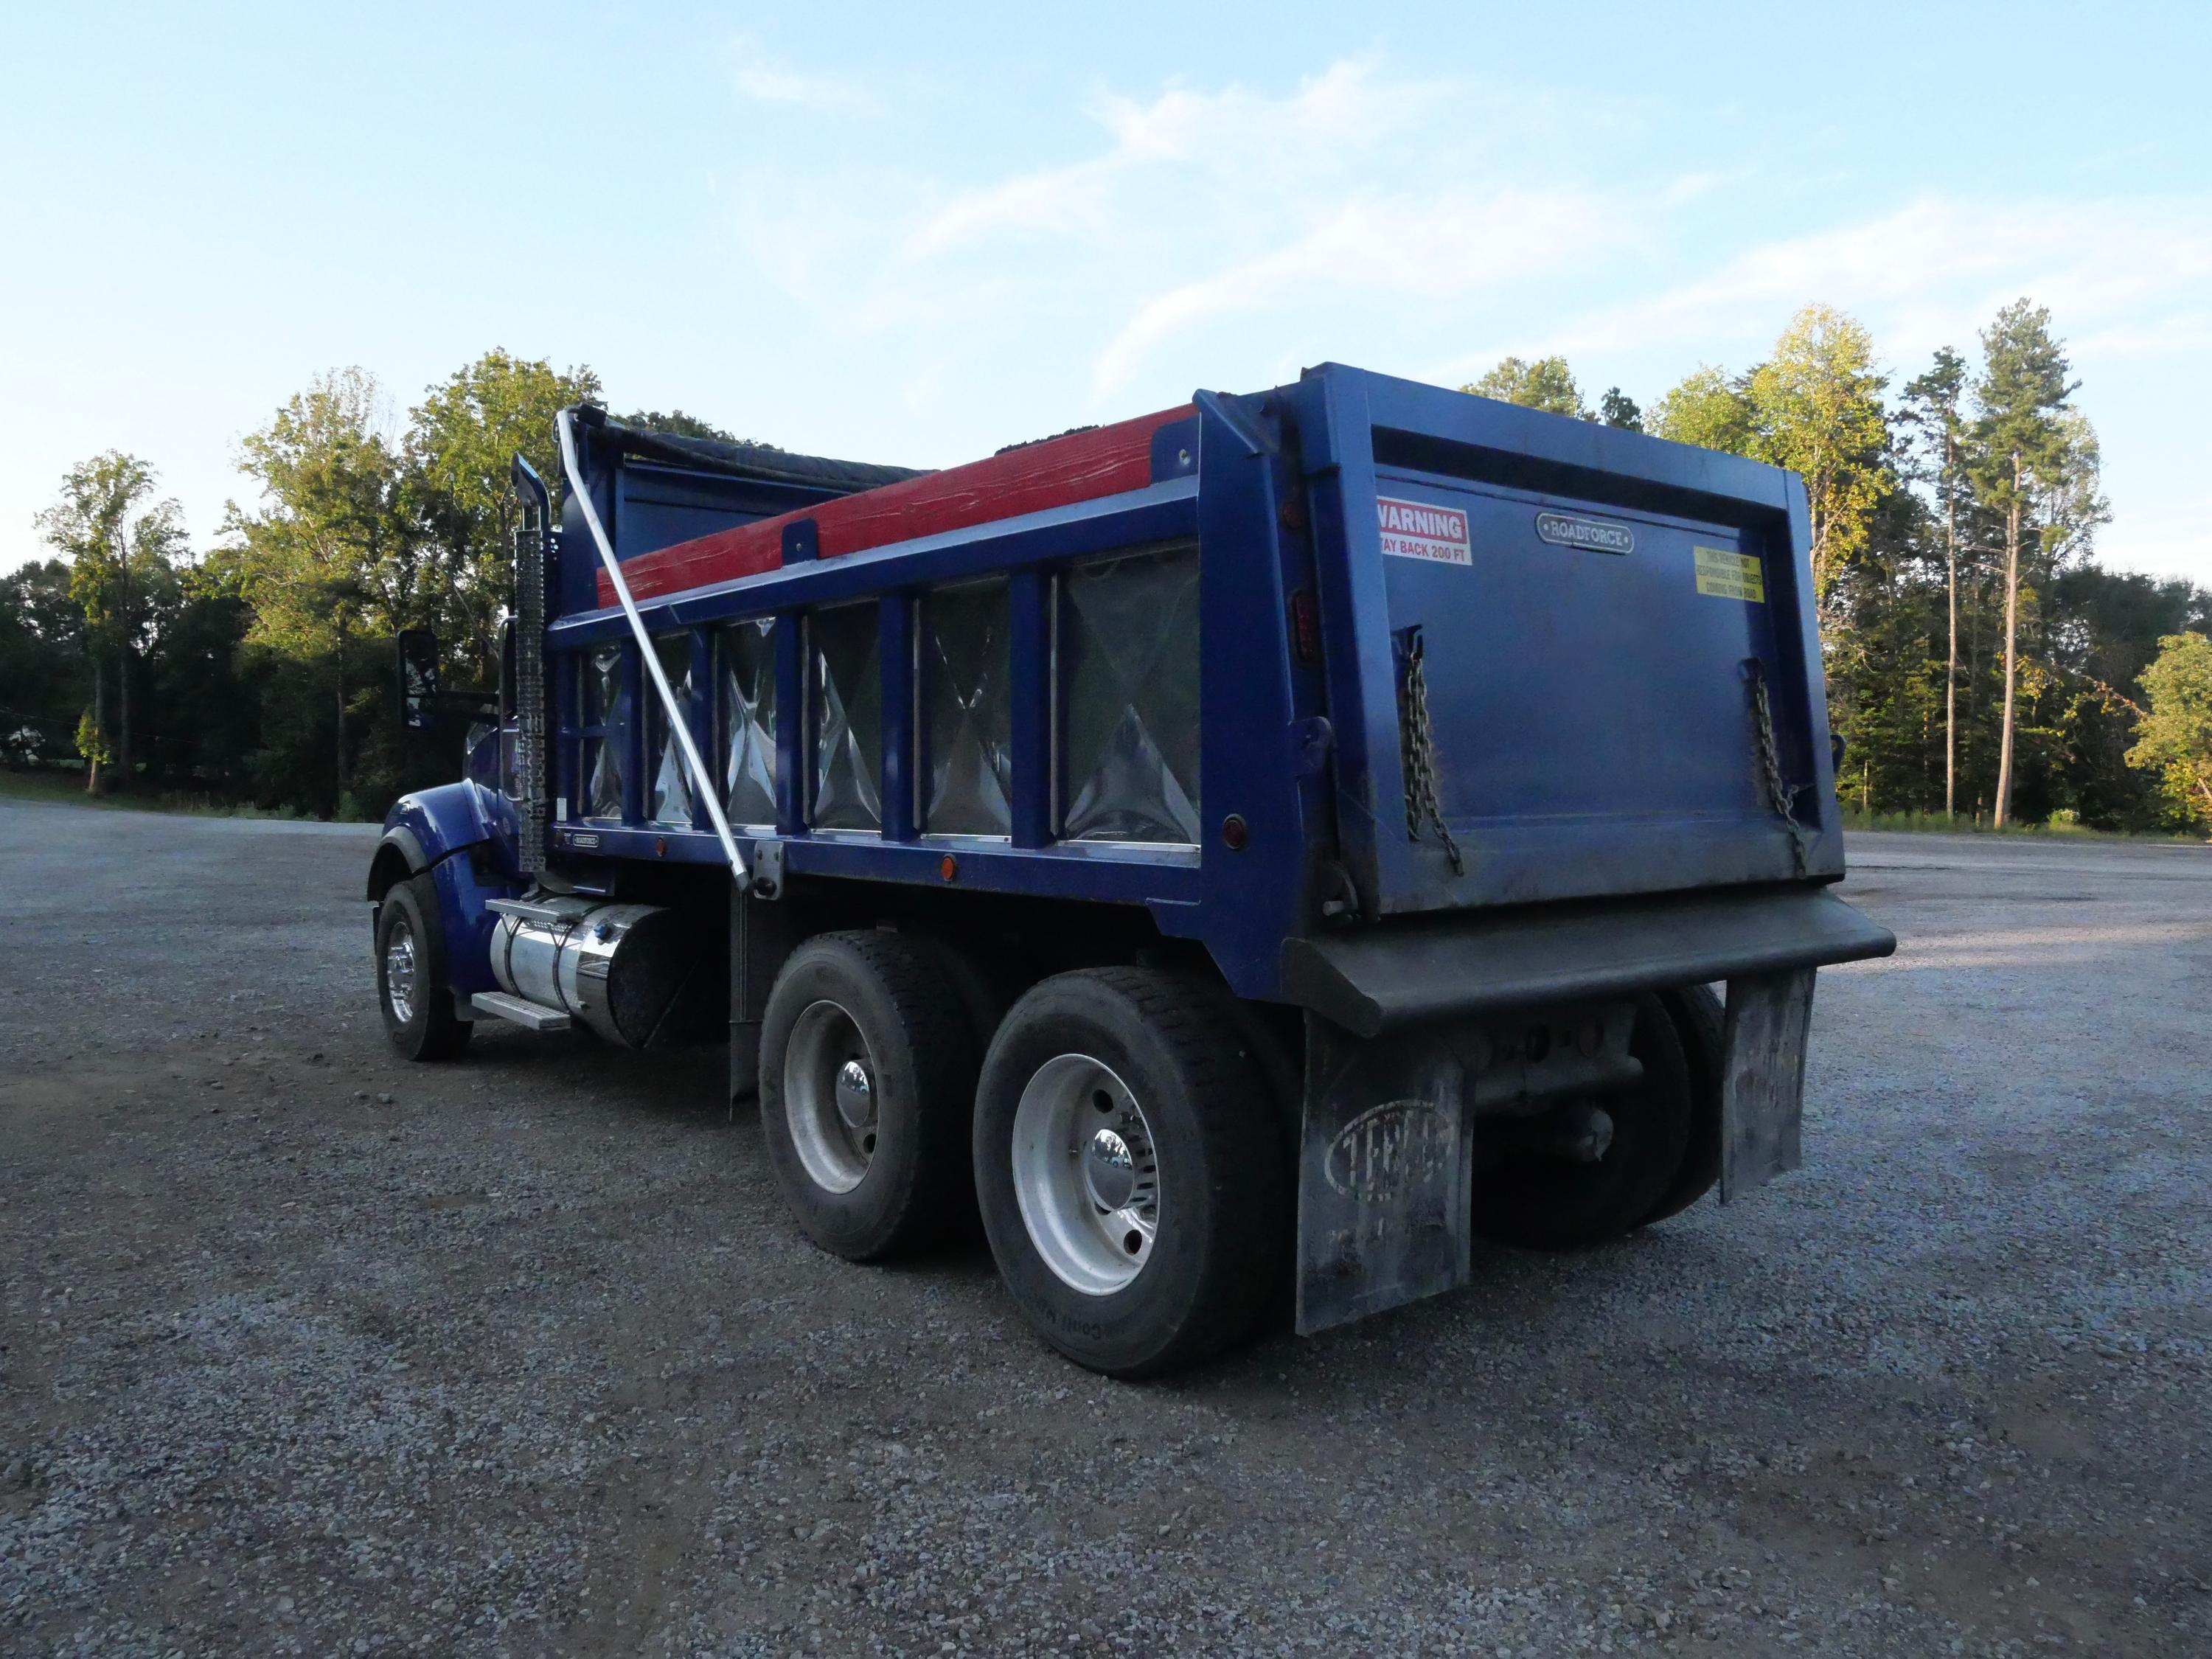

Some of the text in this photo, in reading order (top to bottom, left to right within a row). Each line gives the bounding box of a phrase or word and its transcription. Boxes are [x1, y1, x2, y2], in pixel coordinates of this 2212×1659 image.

[1550, 521, 1623, 546] ROADFORCE
[1380, 538, 1465, 562] AY BACK 200 FT
